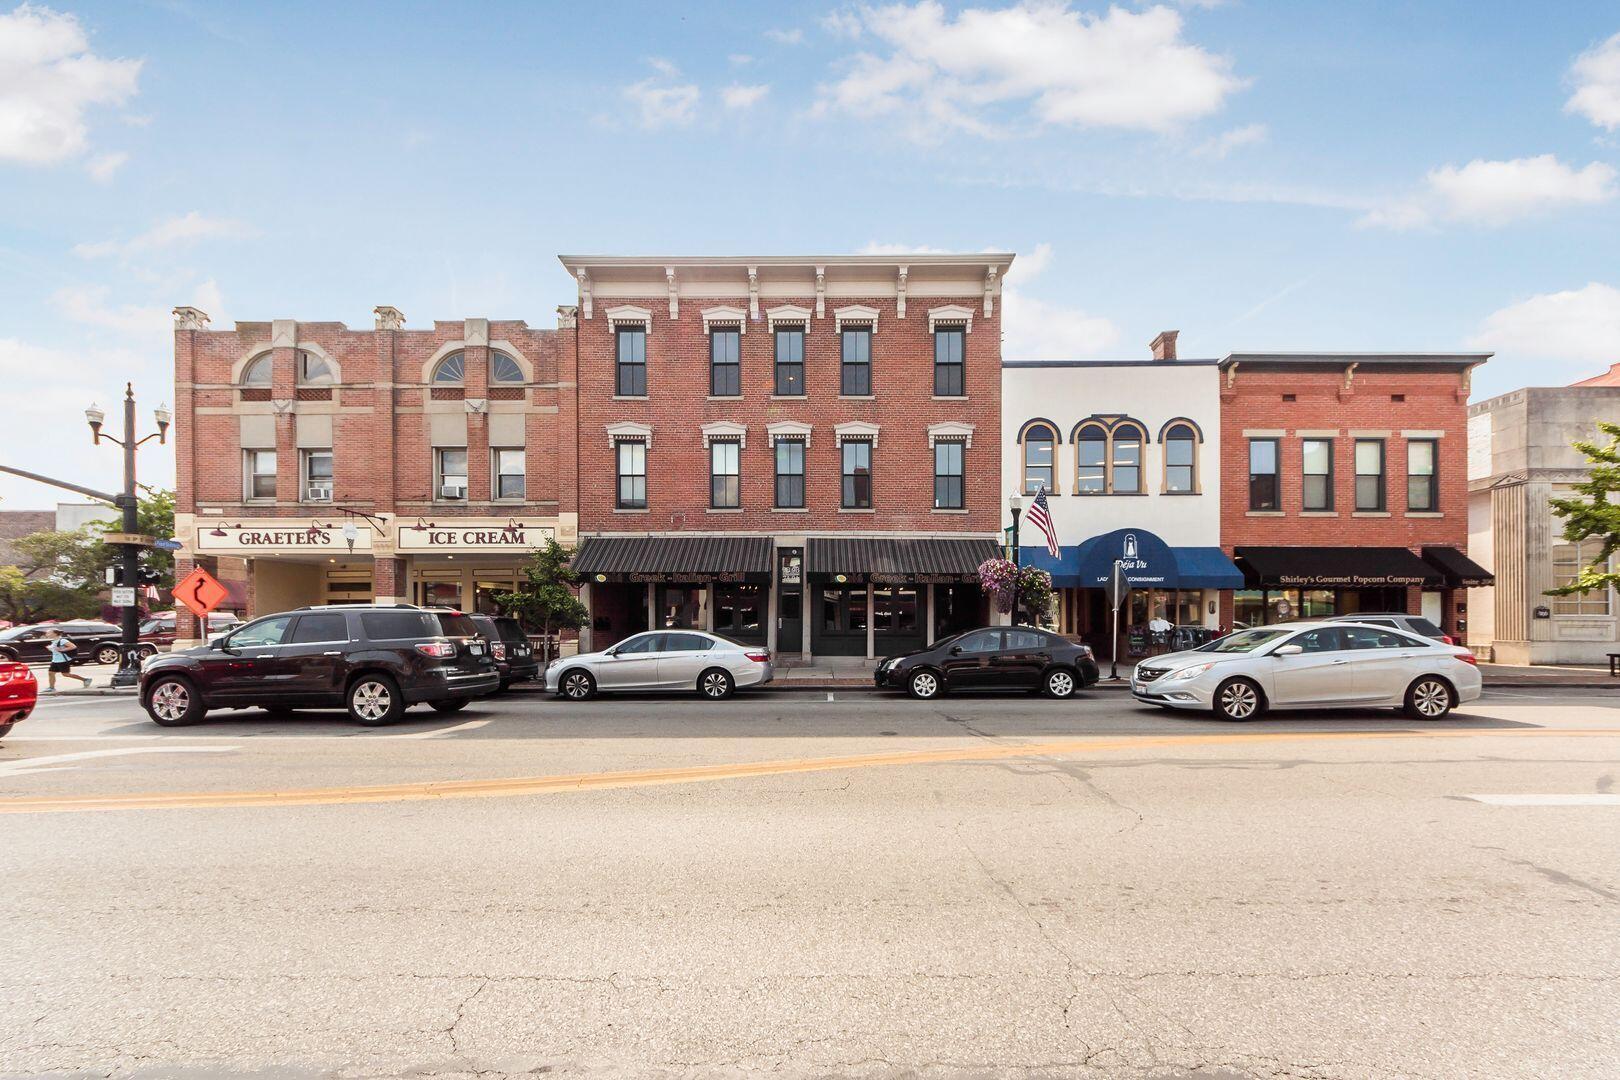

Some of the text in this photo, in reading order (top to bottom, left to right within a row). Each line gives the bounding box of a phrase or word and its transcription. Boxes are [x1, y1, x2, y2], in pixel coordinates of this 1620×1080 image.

[238, 532, 331, 545] GRAETER'S
[428, 531, 525, 545] ICE CREAM
[1136, 560, 1148, 569] Vu
[629, 572, 666, 583] Greek
[719, 571, 745, 583] Grill
[1280, 575, 1425, 585] Shirley's Gourmet Popcorn Company
